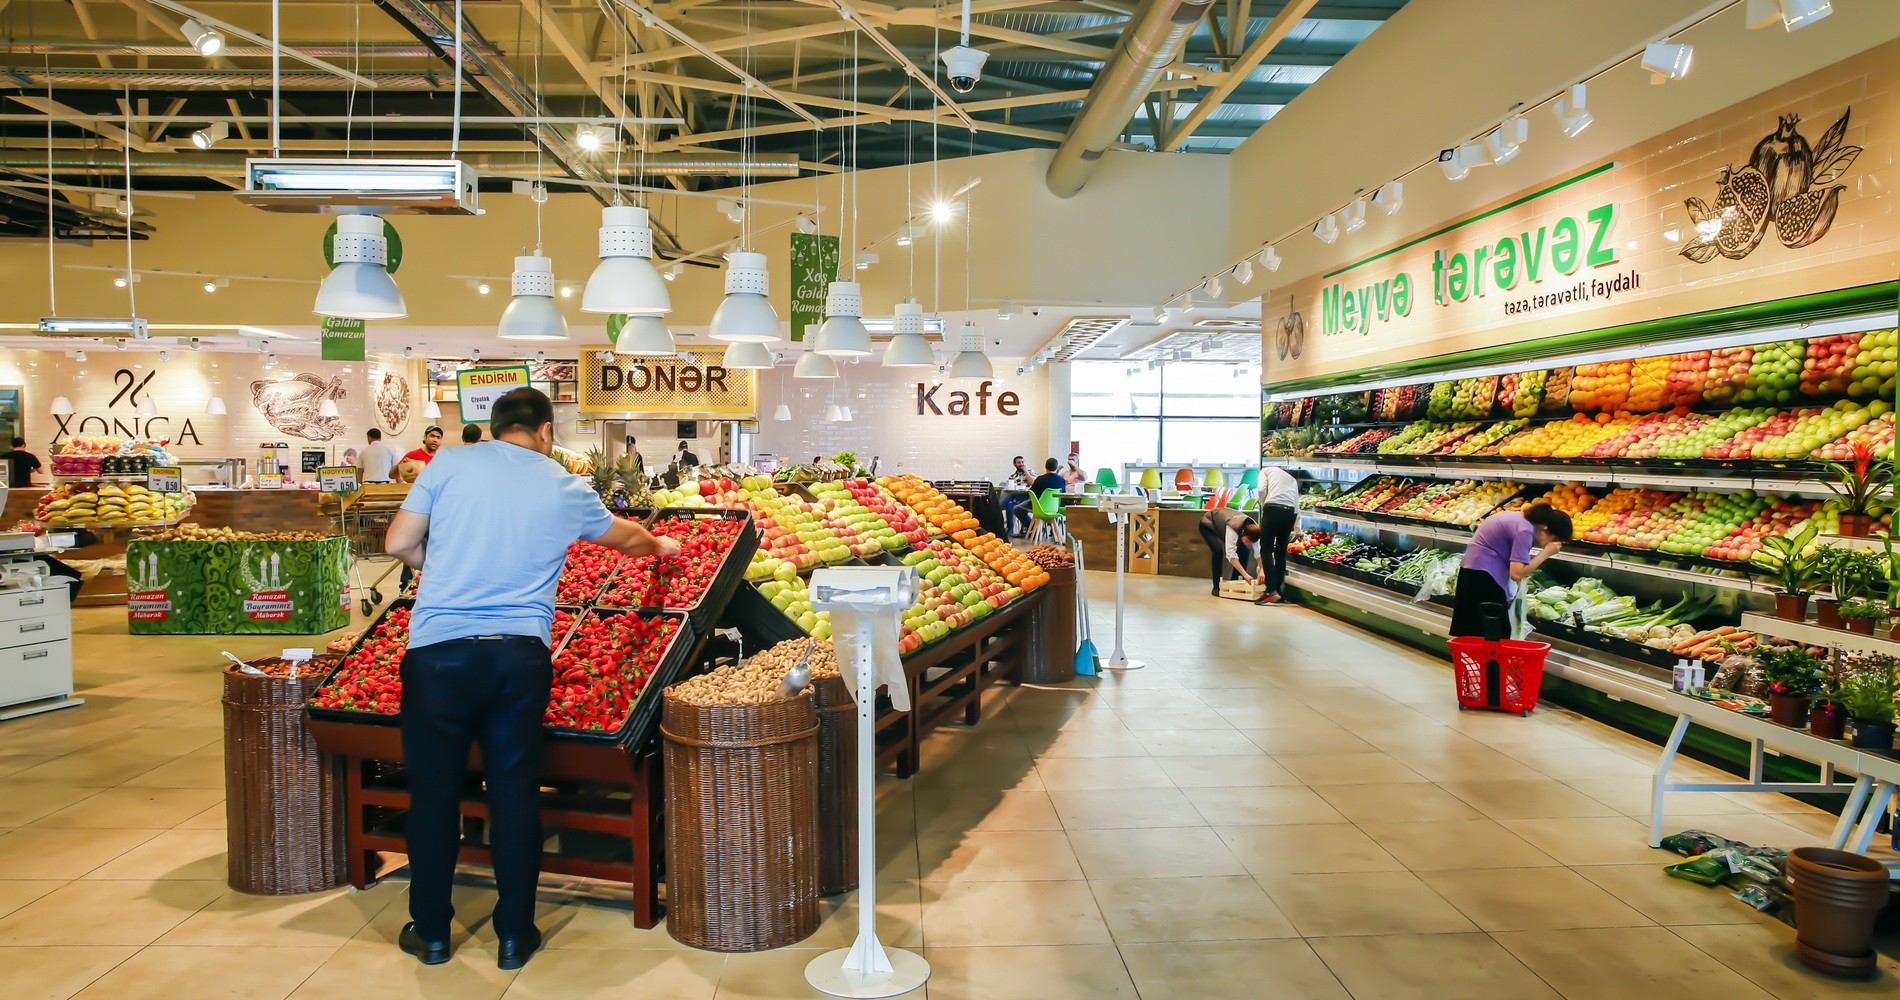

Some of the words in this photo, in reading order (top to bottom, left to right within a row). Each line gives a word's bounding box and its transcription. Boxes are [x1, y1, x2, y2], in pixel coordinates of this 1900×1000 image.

[1323, 272, 1413, 334] Meyvə
[1432, 202, 1620, 307] tərəvəz
[803, 268, 828, 286] Xoş
[797, 285, 828, 300] Gəldi
[1532, 281, 1590, 311] təravətli,
[1591, 269, 1641, 300] faydalı
[792, 300, 827, 314] Ramaz
[326, 317, 361, 328] Gəldin
[321, 328, 365, 339] Ramazan
[470, 371, 517, 385] ENDİRİM
[601, 358, 729, 393] DÖNƏR
[917, 380, 1020, 416] Kafe
